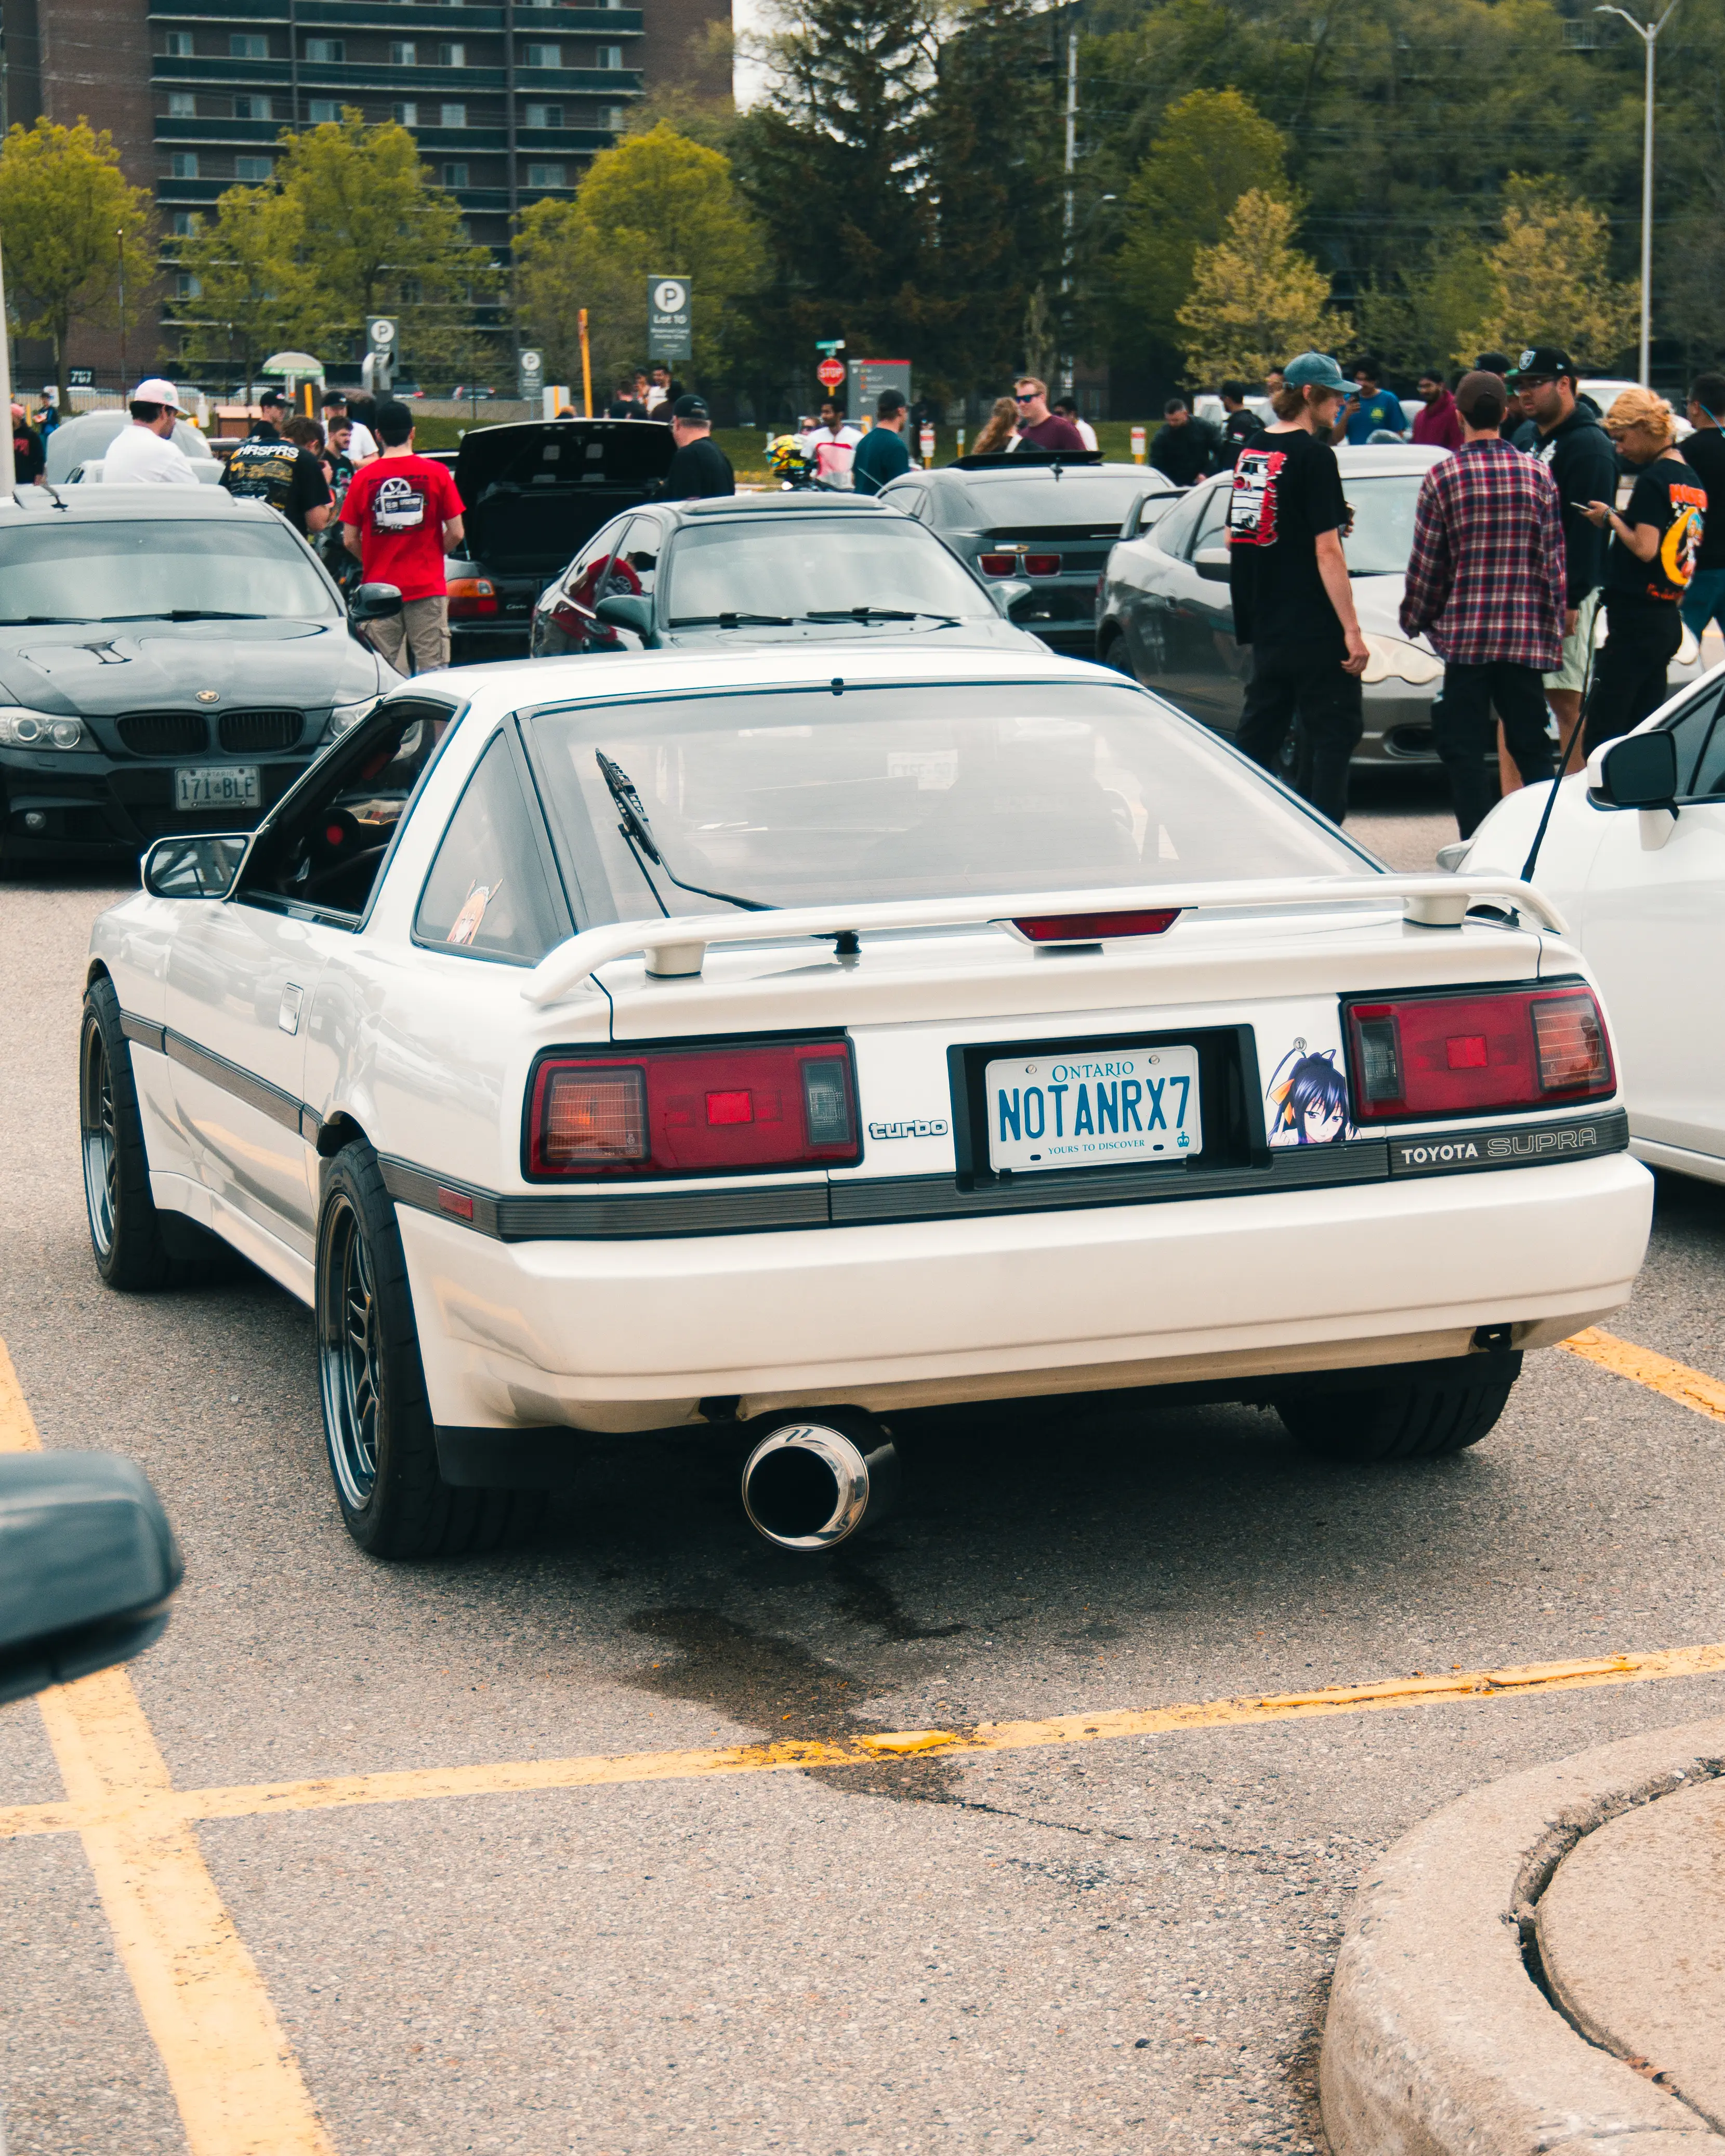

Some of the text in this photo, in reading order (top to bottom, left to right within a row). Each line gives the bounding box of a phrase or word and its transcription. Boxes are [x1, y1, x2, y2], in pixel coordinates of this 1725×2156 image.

[664, 288, 677, 307] P
[379, 325, 388, 338] P
[820, 367, 844, 378] STOP
[182, 777, 255, 800] 171 BLE
[1052, 1061, 1134, 1082] ONTARIO
[998, 1076, 1190, 1142] NOTANRX7
[869, 1120, 948, 1140] turbo
[1048, 1145, 1078, 1154] YOURS
[1099, 1140, 1145, 1150] DISCOVER
[1401, 1127, 1597, 1164] TOYOTA SUPRA
